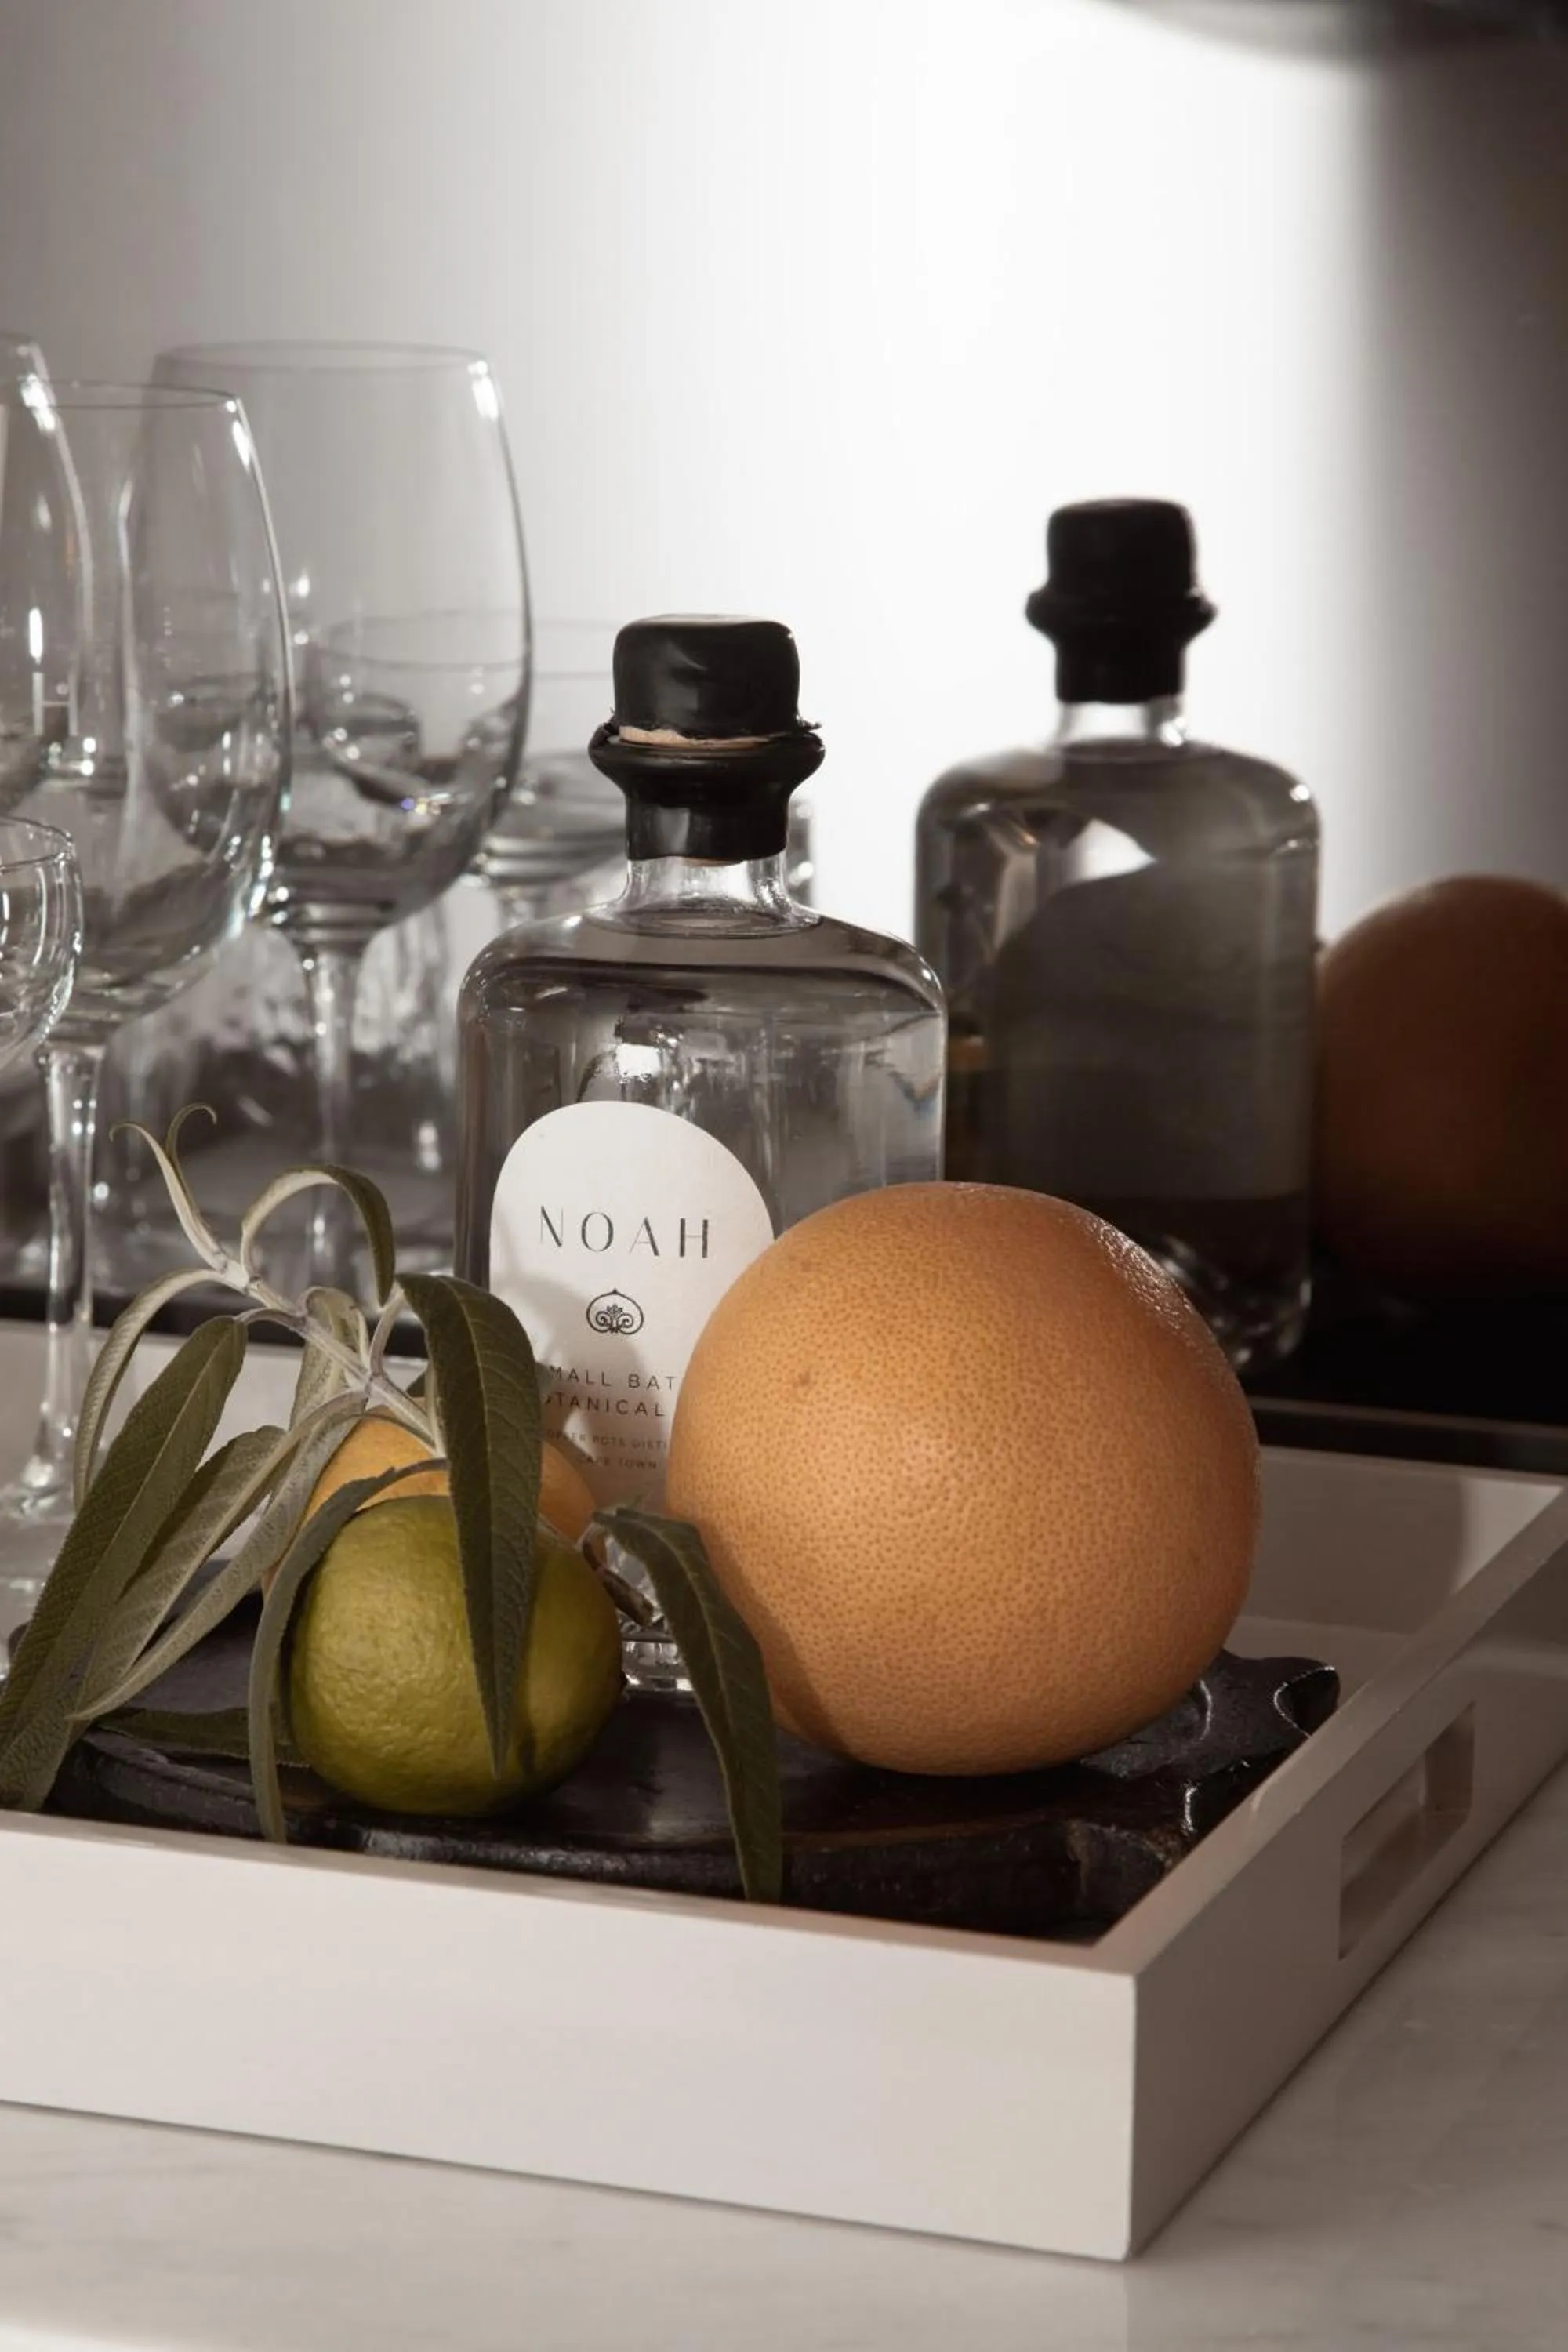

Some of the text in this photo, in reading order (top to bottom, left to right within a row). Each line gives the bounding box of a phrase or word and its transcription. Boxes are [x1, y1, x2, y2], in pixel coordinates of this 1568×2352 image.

[539, 1205, 709, 1258] NOAH
[549, 1365, 677, 1391] MALL BAT
[544, 1391, 666, 1417] TANICAL
